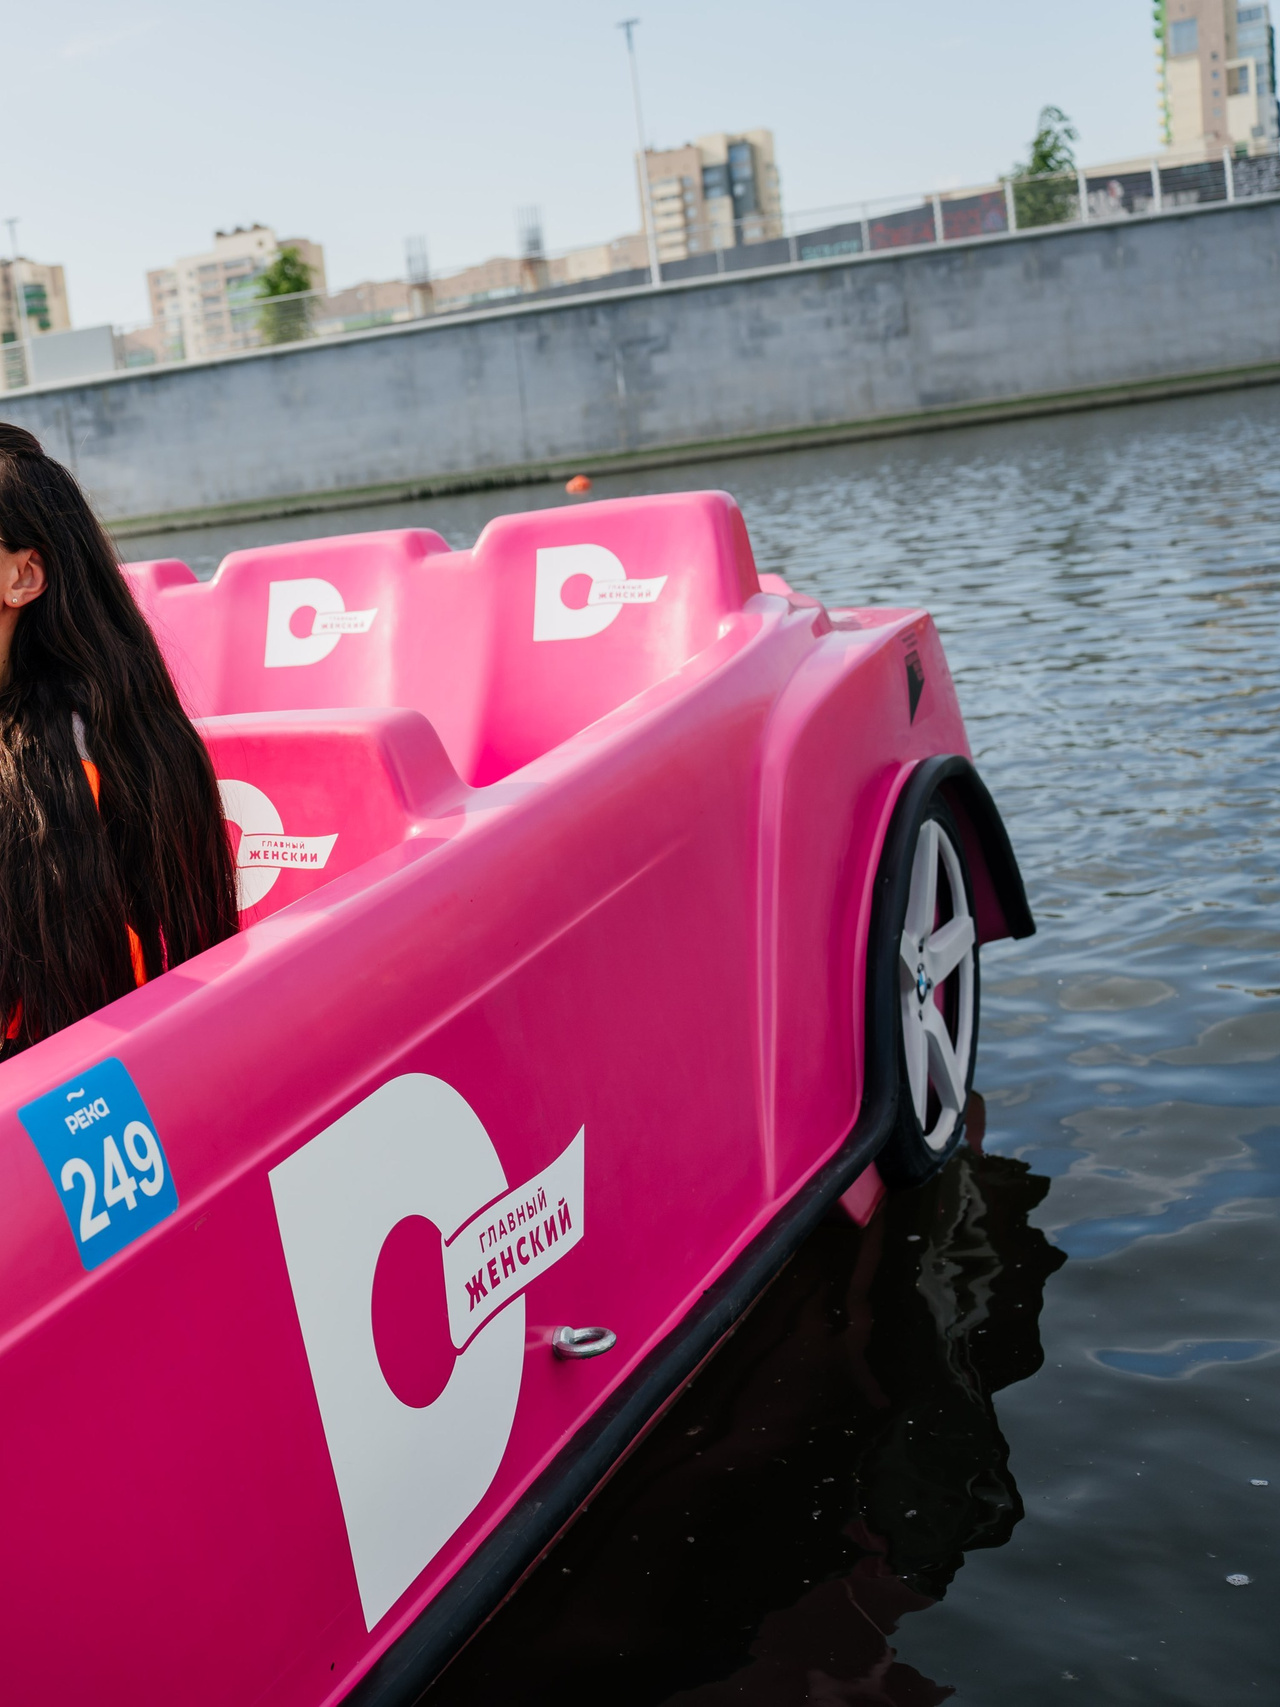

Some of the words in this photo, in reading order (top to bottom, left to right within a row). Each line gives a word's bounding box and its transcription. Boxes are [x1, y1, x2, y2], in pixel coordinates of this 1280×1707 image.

[261, 840, 305, 850] ГЛАВНЫЙ
[60, 1120, 165, 1243] 249
[478, 1186, 548, 1254] ГЛАВНЫЙ
[464, 1196, 573, 1313] ЖЕНСКИЙ
